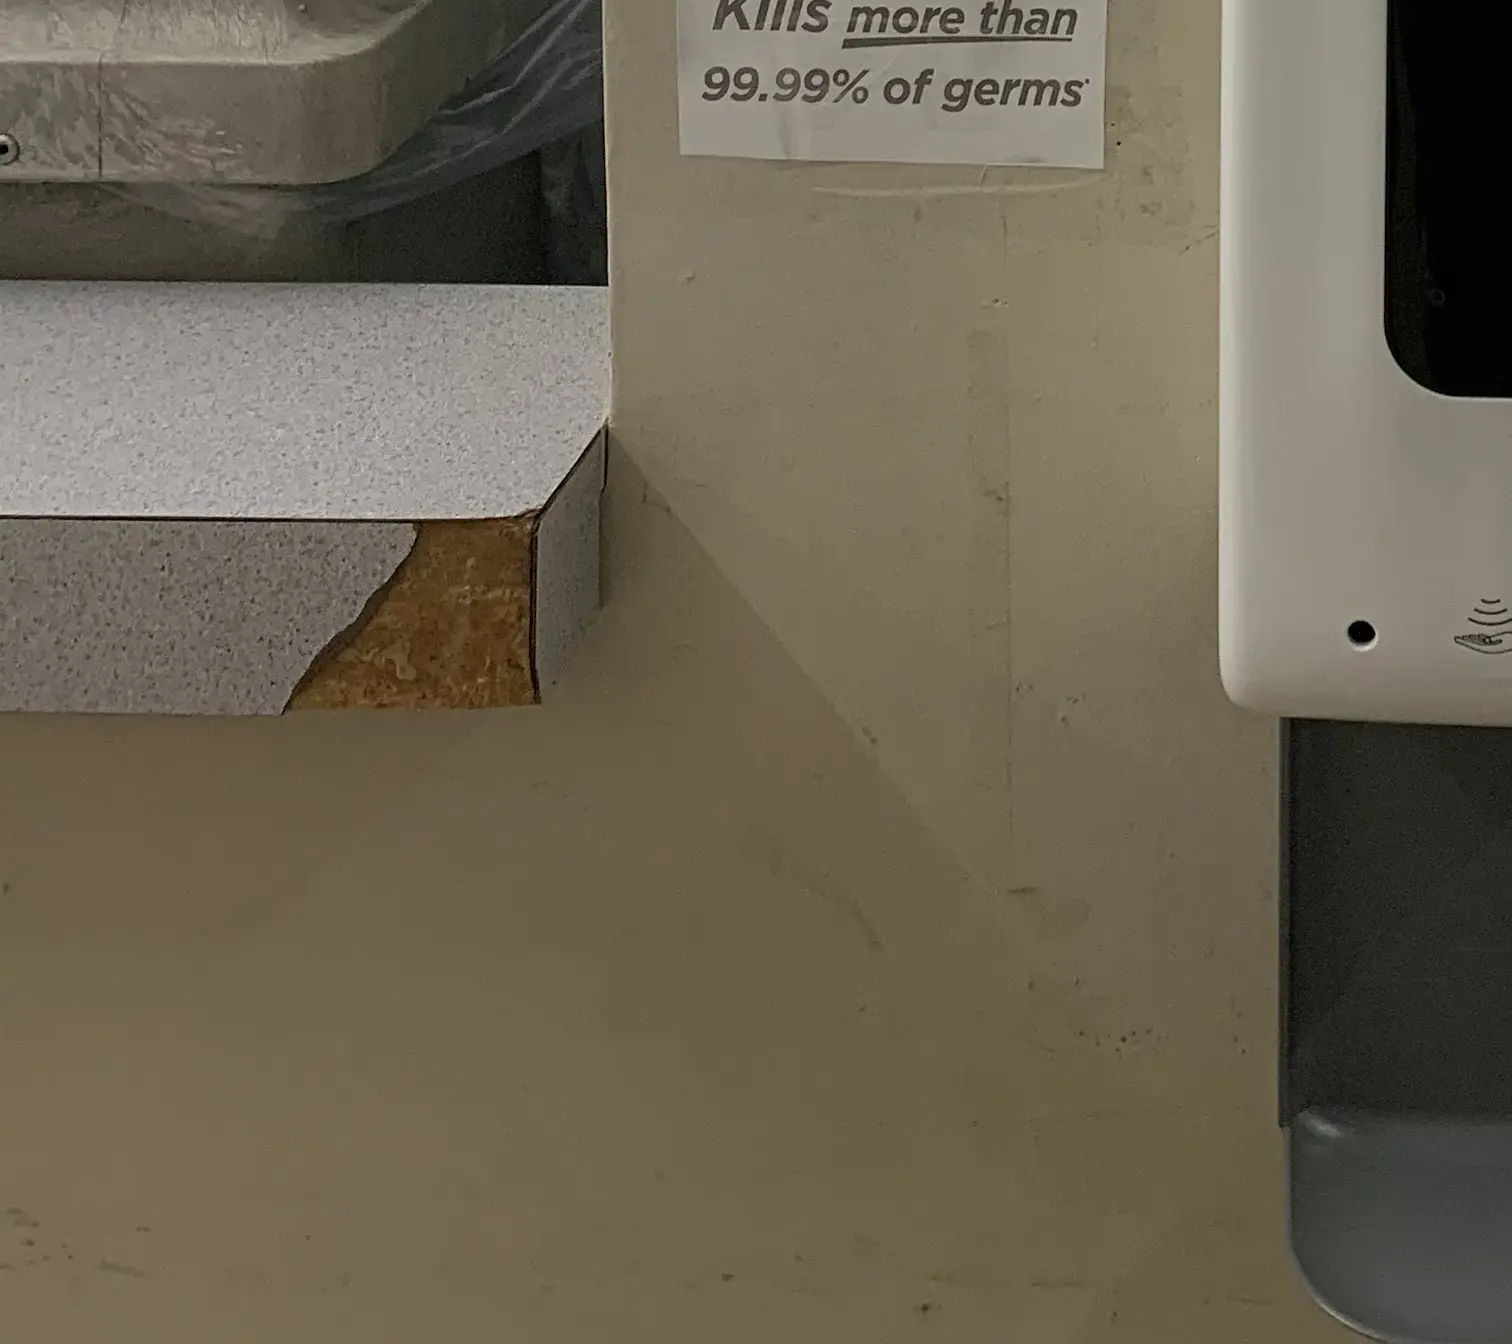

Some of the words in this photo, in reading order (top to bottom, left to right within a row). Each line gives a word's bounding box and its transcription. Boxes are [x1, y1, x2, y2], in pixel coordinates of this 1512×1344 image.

[846, 3, 965, 36] more
[979, 0, 1078, 36] than
[701, 66, 870, 105] 99.99%
[882, 68, 935, 106] of
